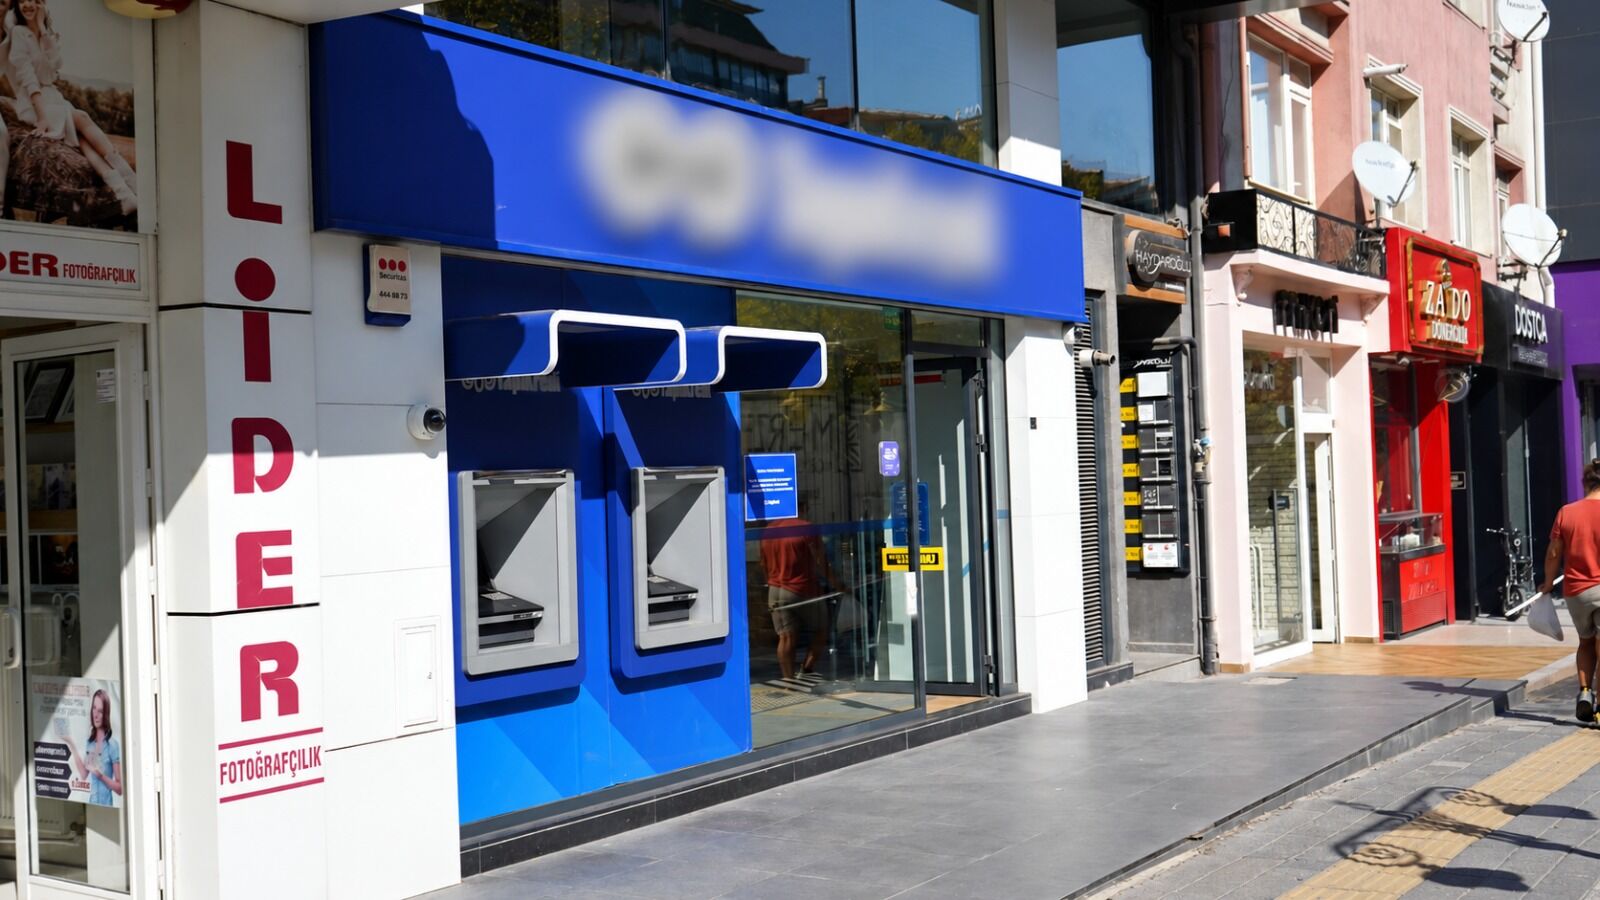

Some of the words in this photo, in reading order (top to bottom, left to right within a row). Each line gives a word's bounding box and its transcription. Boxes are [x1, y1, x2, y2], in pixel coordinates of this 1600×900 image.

[63, 262, 136, 284] FOTOĞRAFÇILIK
[379, 271, 407, 281] Securitas
[1514, 303, 1548, 344] DOSTÇA
[220, 745, 321, 786] FOTOĞRAFÇILIK
